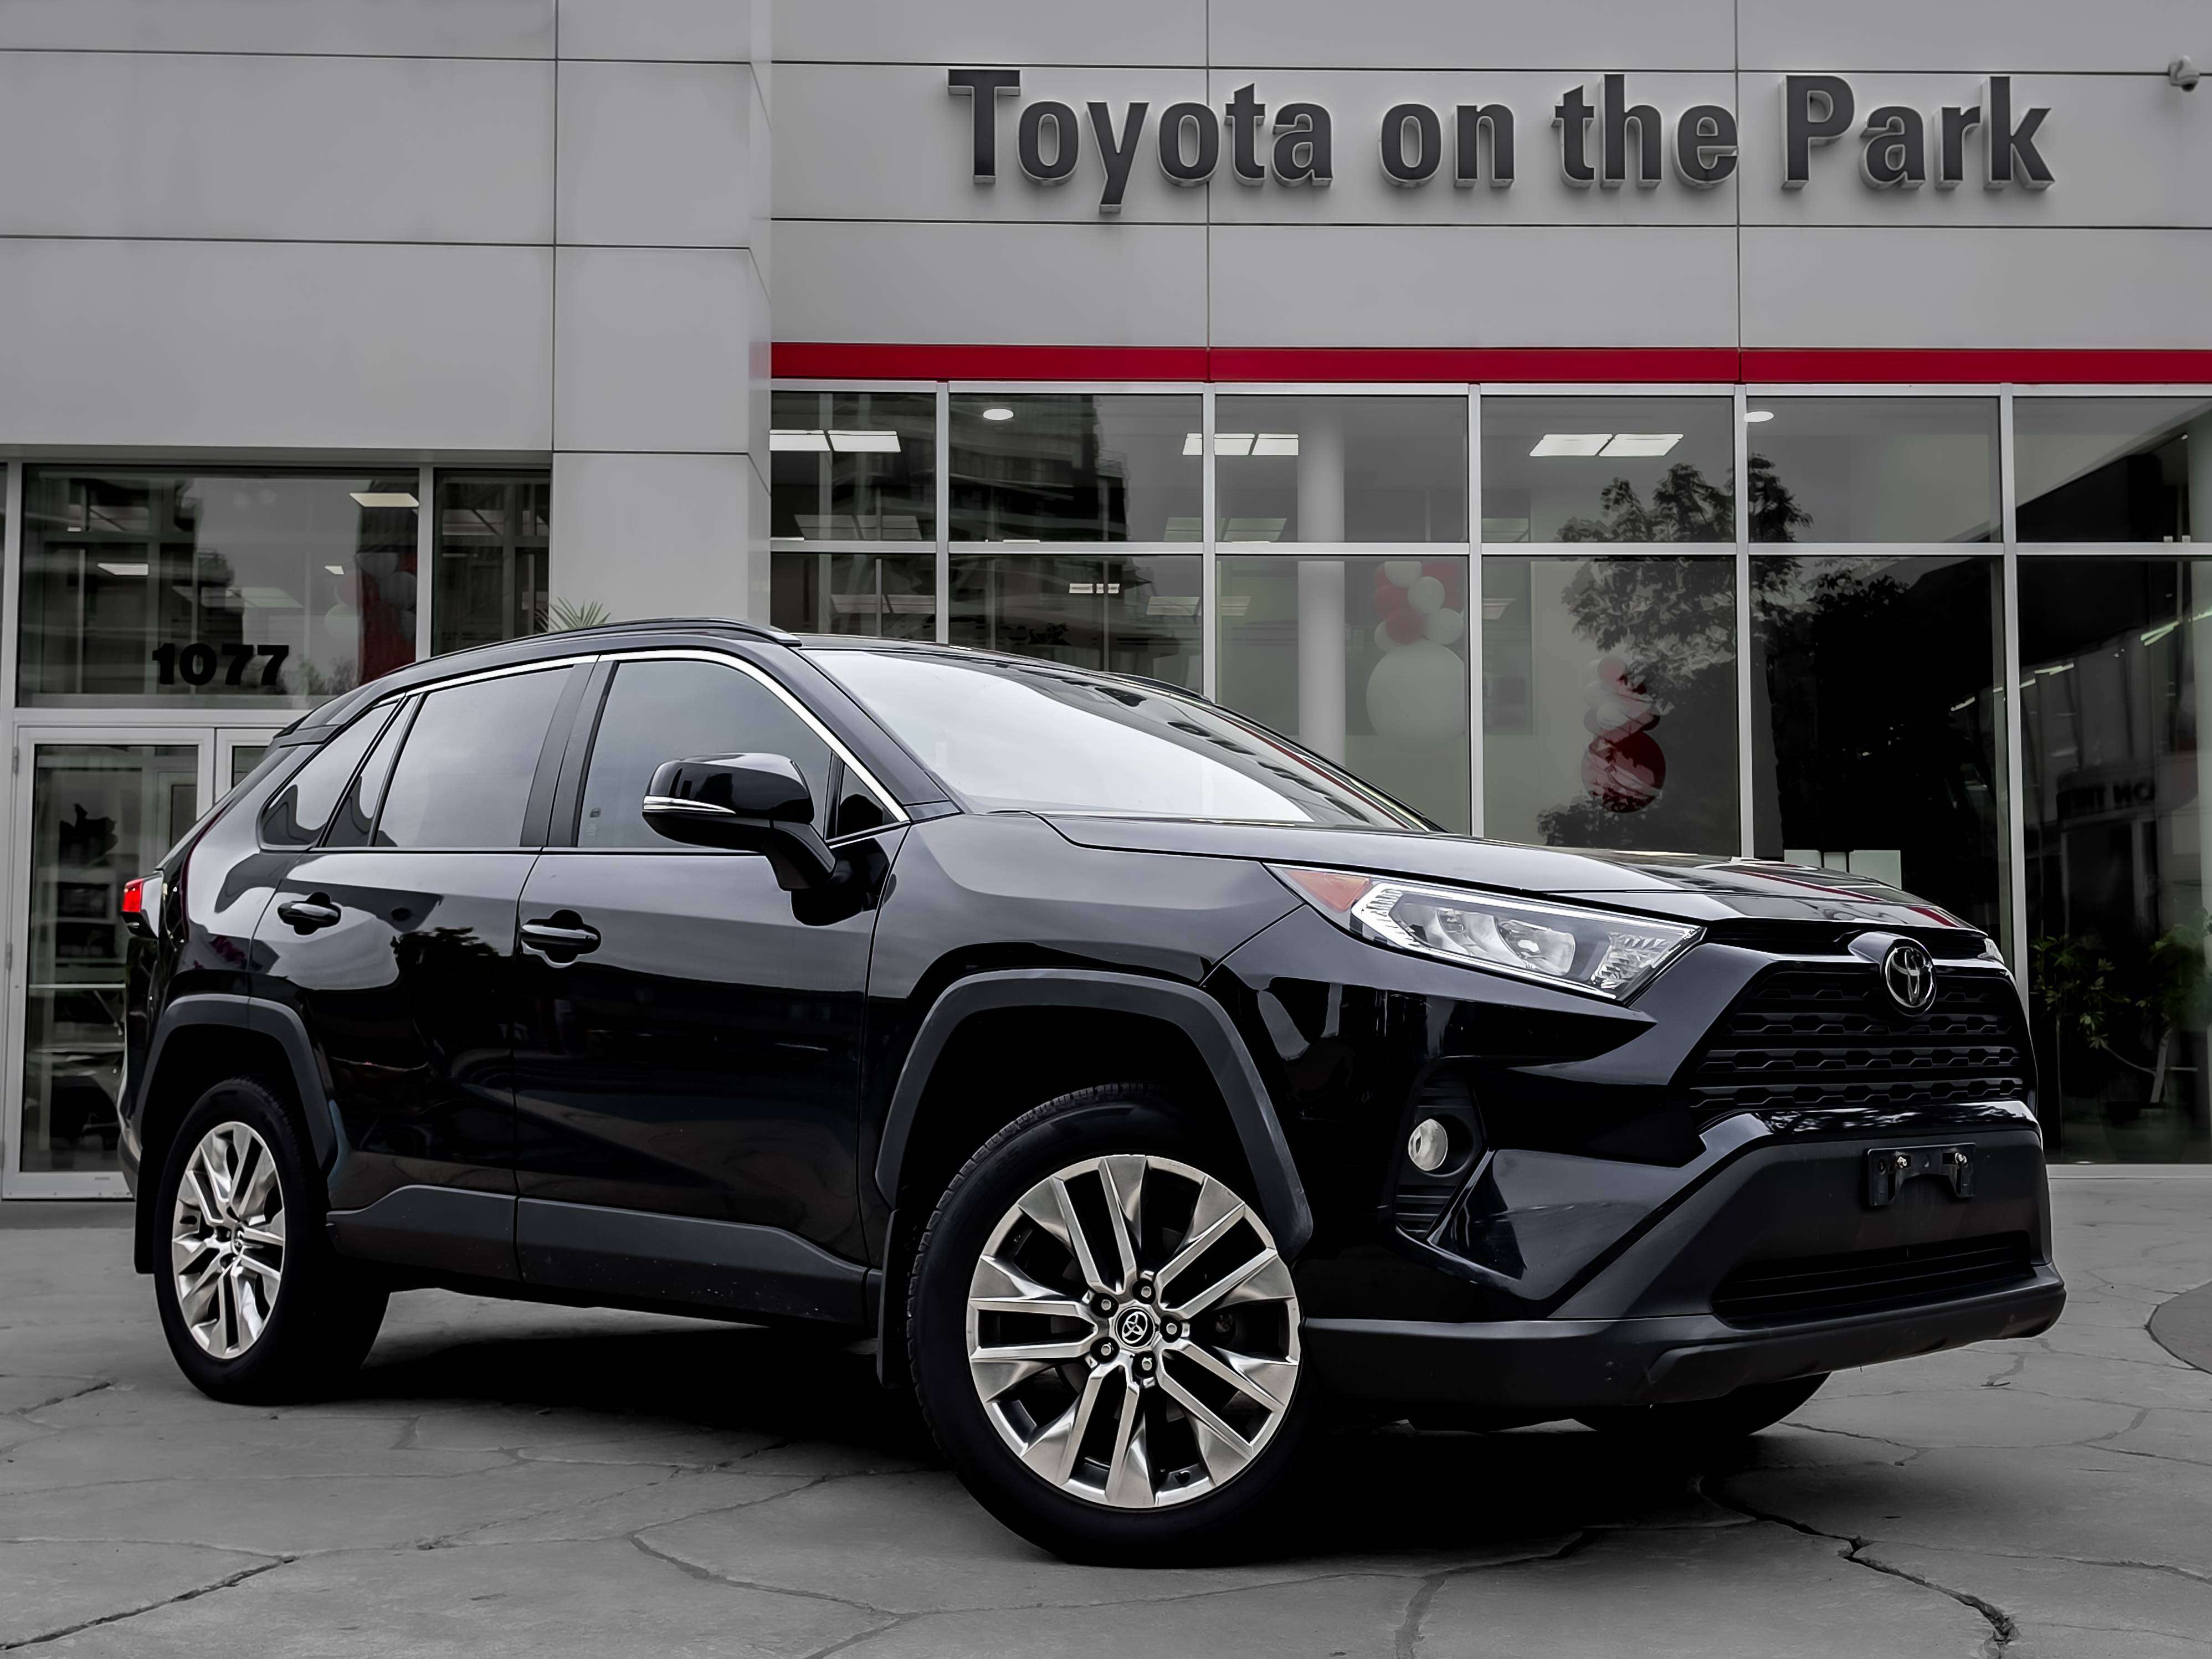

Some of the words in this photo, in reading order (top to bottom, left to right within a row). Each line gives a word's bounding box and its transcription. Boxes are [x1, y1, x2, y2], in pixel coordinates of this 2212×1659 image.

[947, 69, 1333, 212] Toyota
[1379, 103, 1515, 188] on
[1552, 74, 1738, 188] the
[1779, 75, 2055, 190] Park
[152, 643, 289, 686] 1077
